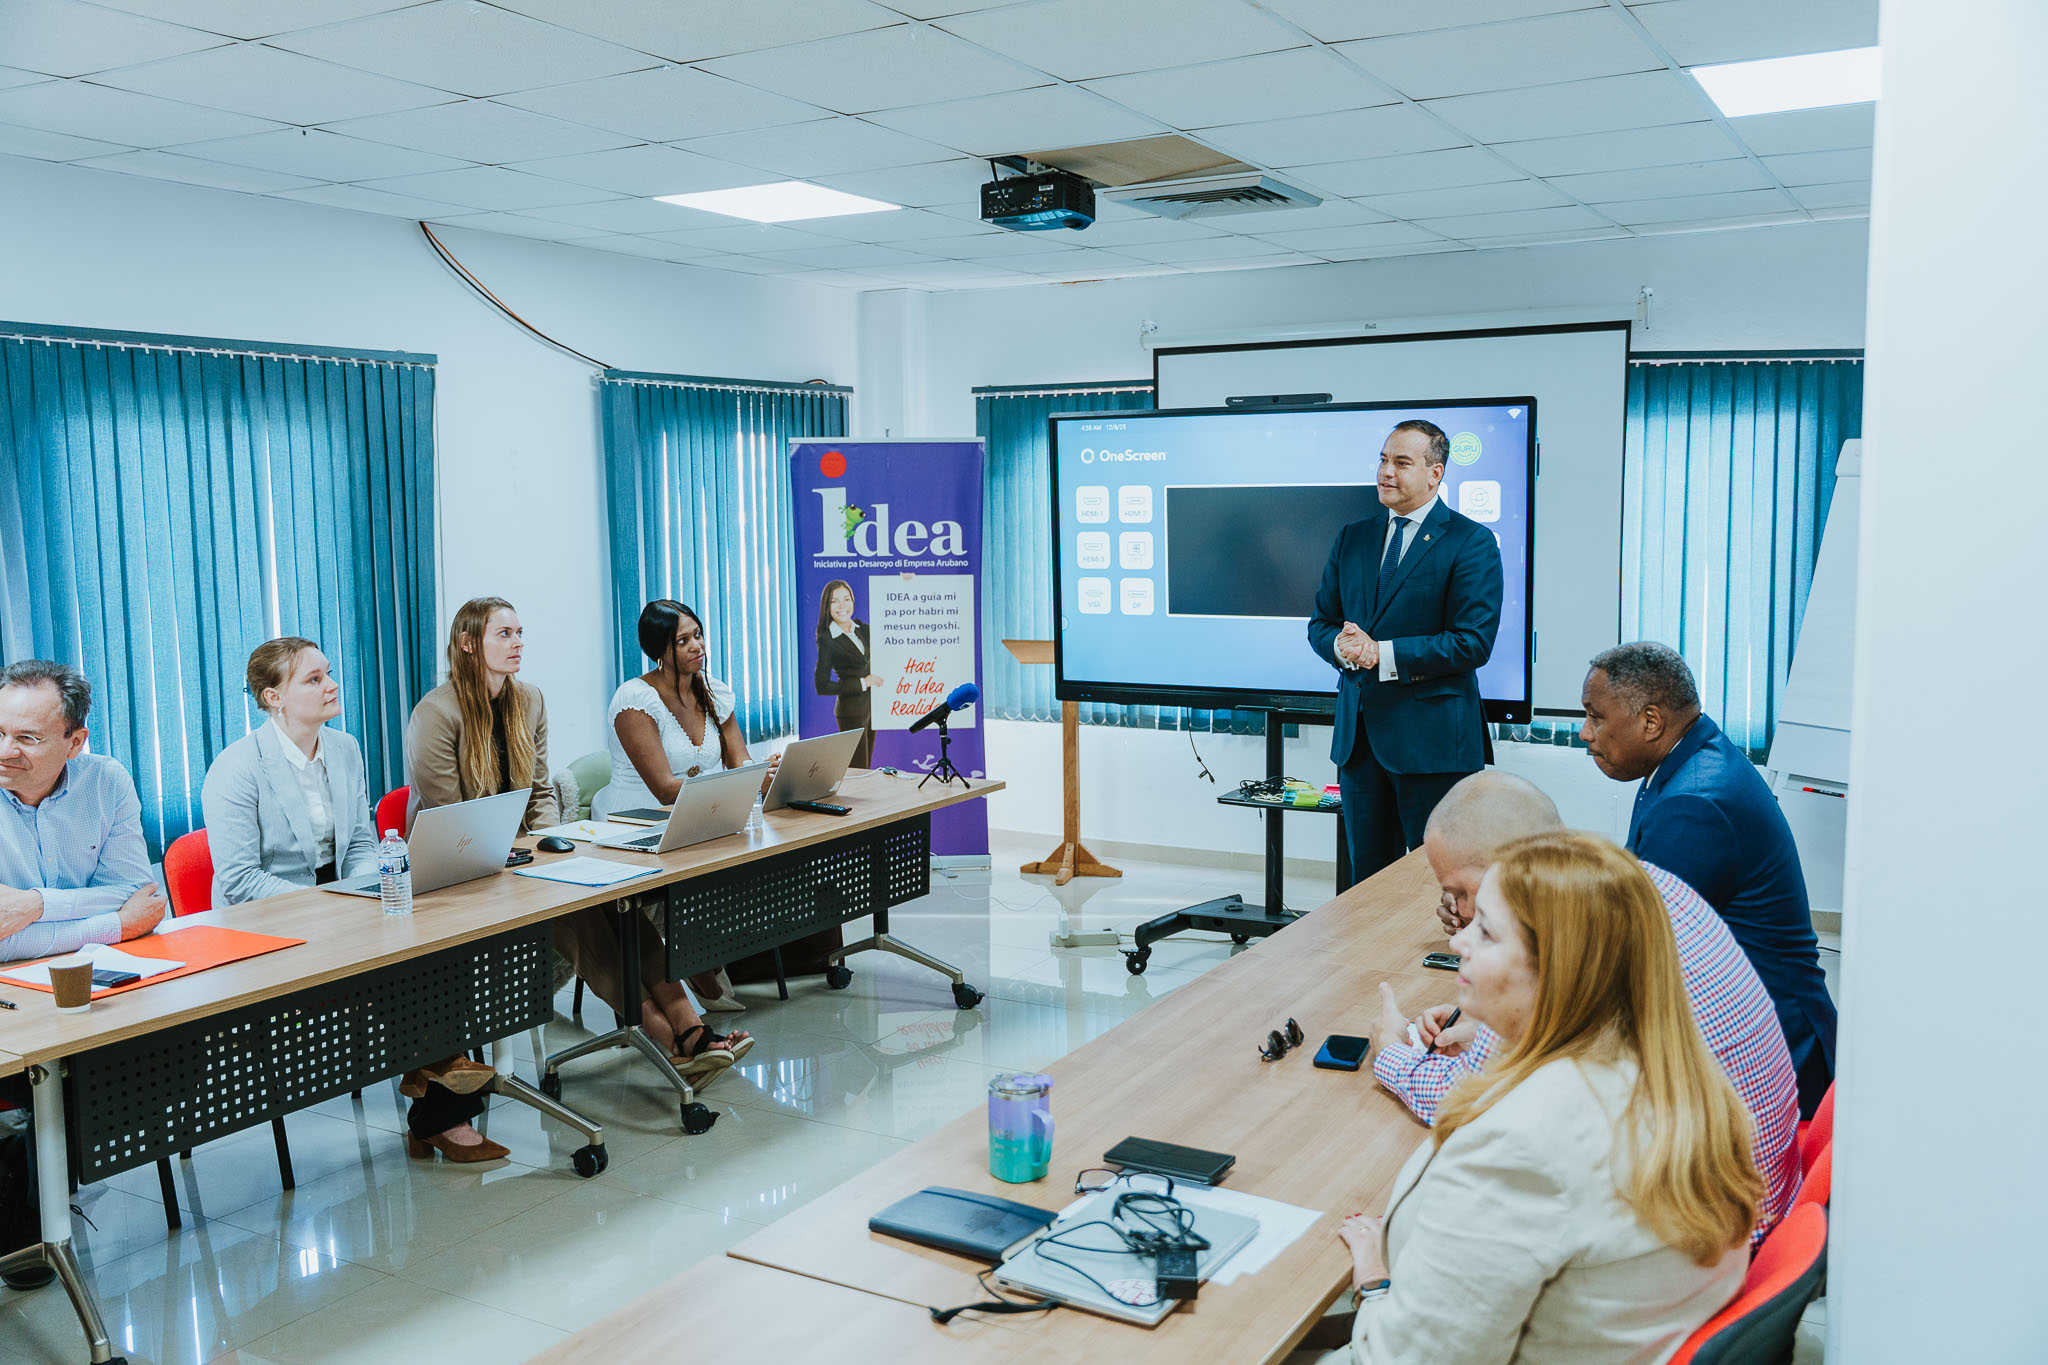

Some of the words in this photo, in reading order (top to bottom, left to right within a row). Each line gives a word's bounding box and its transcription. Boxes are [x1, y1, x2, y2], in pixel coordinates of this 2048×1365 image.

[1453, 445, 1478, 453] GURU
[1099, 449, 1167, 462] OneScreen
[814, 560, 847, 569] Iniciativa
[848, 561, 858, 570] pa
[859, 560, 894, 569] Desaroyo
[895, 559, 902, 567] di
[903, 559, 935, 568] Empresa
[936, 558, 969, 567] Arubano
[886, 592, 910, 601] IDEA
[920, 592, 942, 603] guia
[944, 592, 956, 601] mi
[884, 609, 897, 618] pa
[899, 609, 916, 618] por
[918, 607, 944, 615] habri
[946, 606, 959, 615] mi
[918, 621, 960, 632] negoshi.
[884, 637, 905, 645] Abo
[906, 636, 938, 645] tambe
[939, 636, 960, 646] por!
[904, 656, 937, 674] Haci
[896, 676, 912, 694] bo
[915, 676, 945, 695] Idea
[890, 697, 941, 716] Realid
